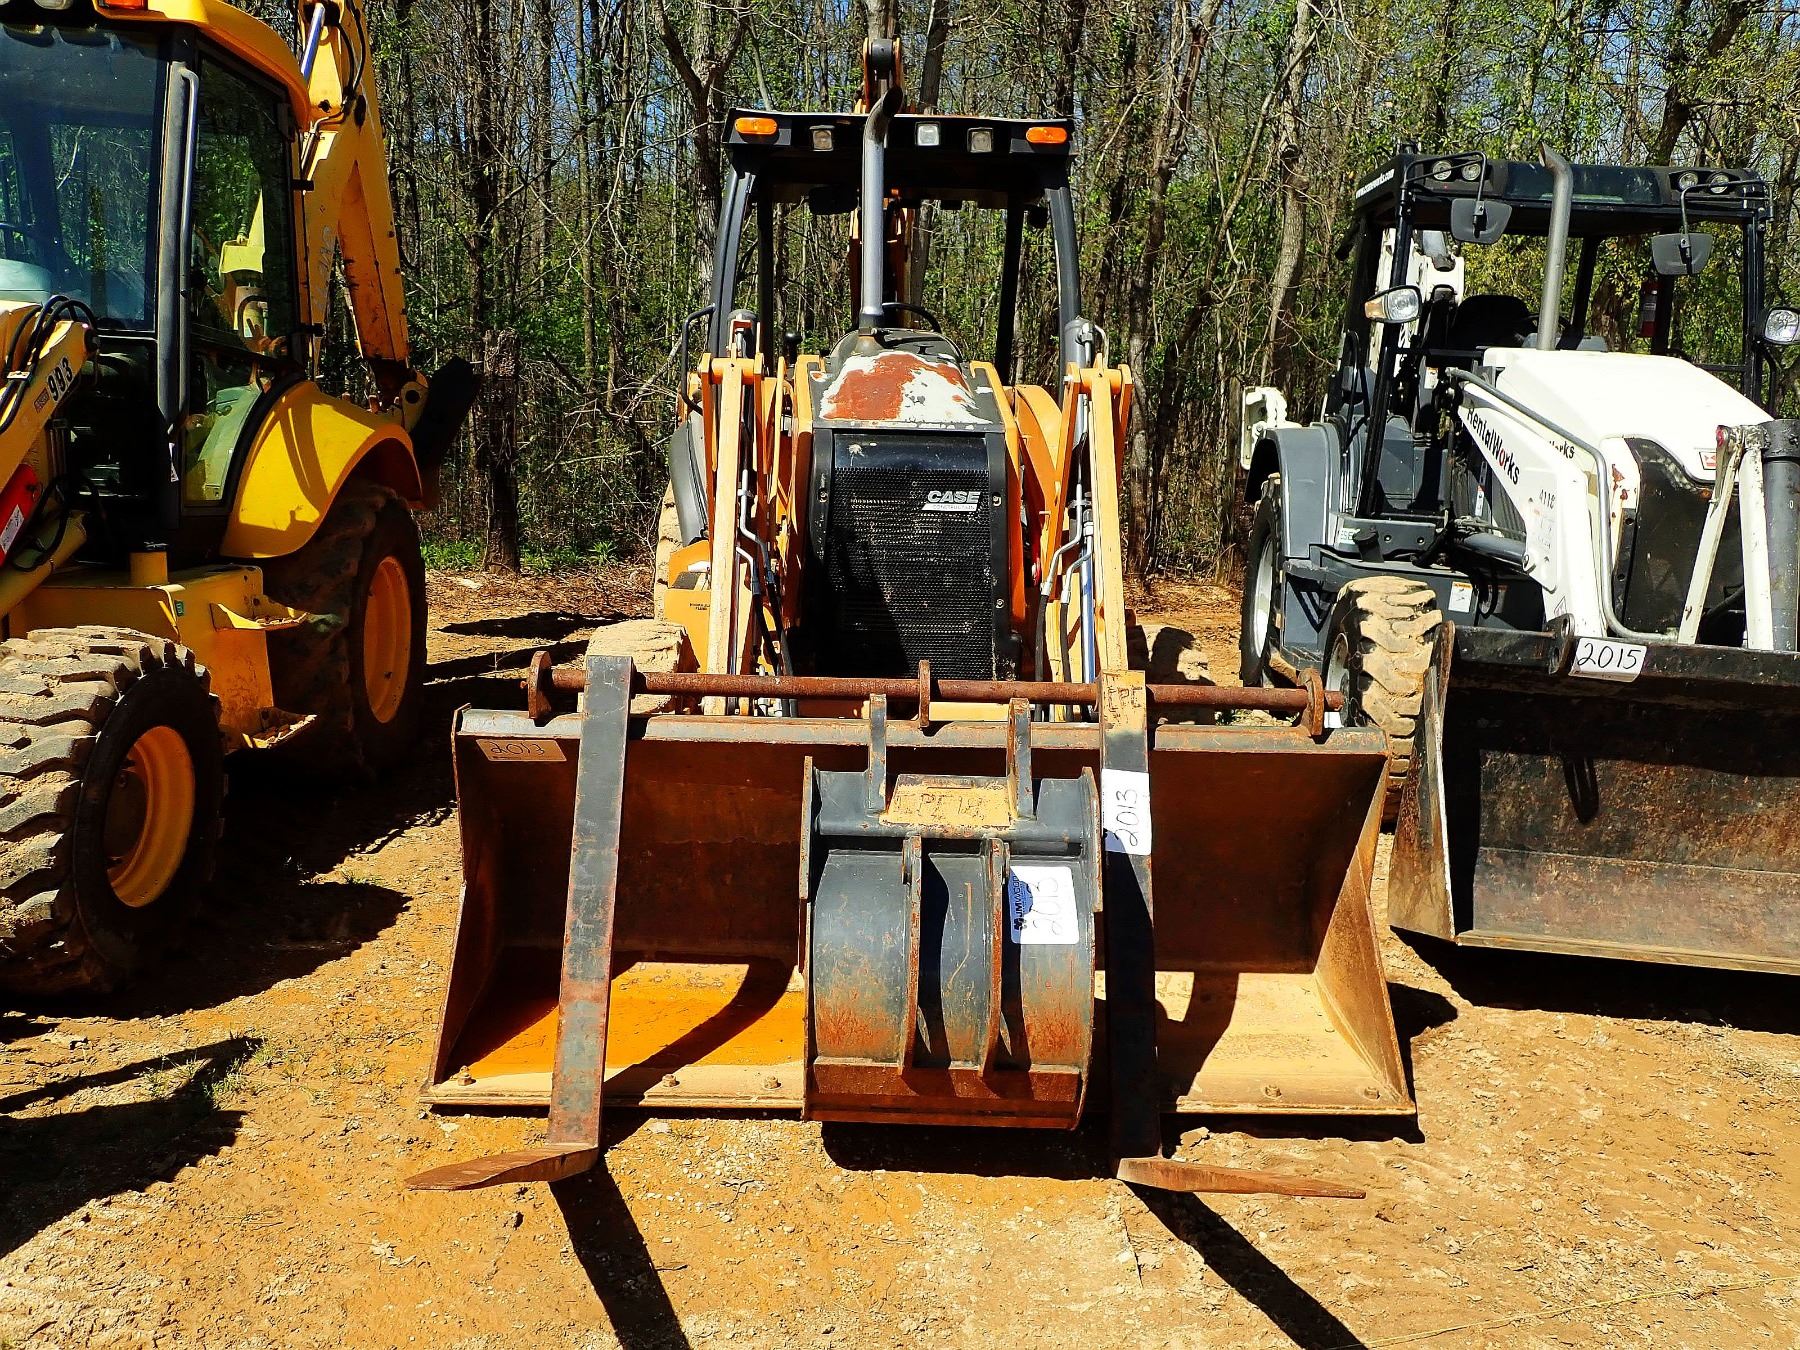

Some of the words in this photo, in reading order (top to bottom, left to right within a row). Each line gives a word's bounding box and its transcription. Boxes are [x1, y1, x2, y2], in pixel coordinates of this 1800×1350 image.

[47, 356, 73, 402] 993
[1467, 408, 1520, 485] RentalWorks
[927, 490, 981, 504] CASE
[1577, 642, 1642, 670] 2015
[1112, 789, 1140, 847] 2013
